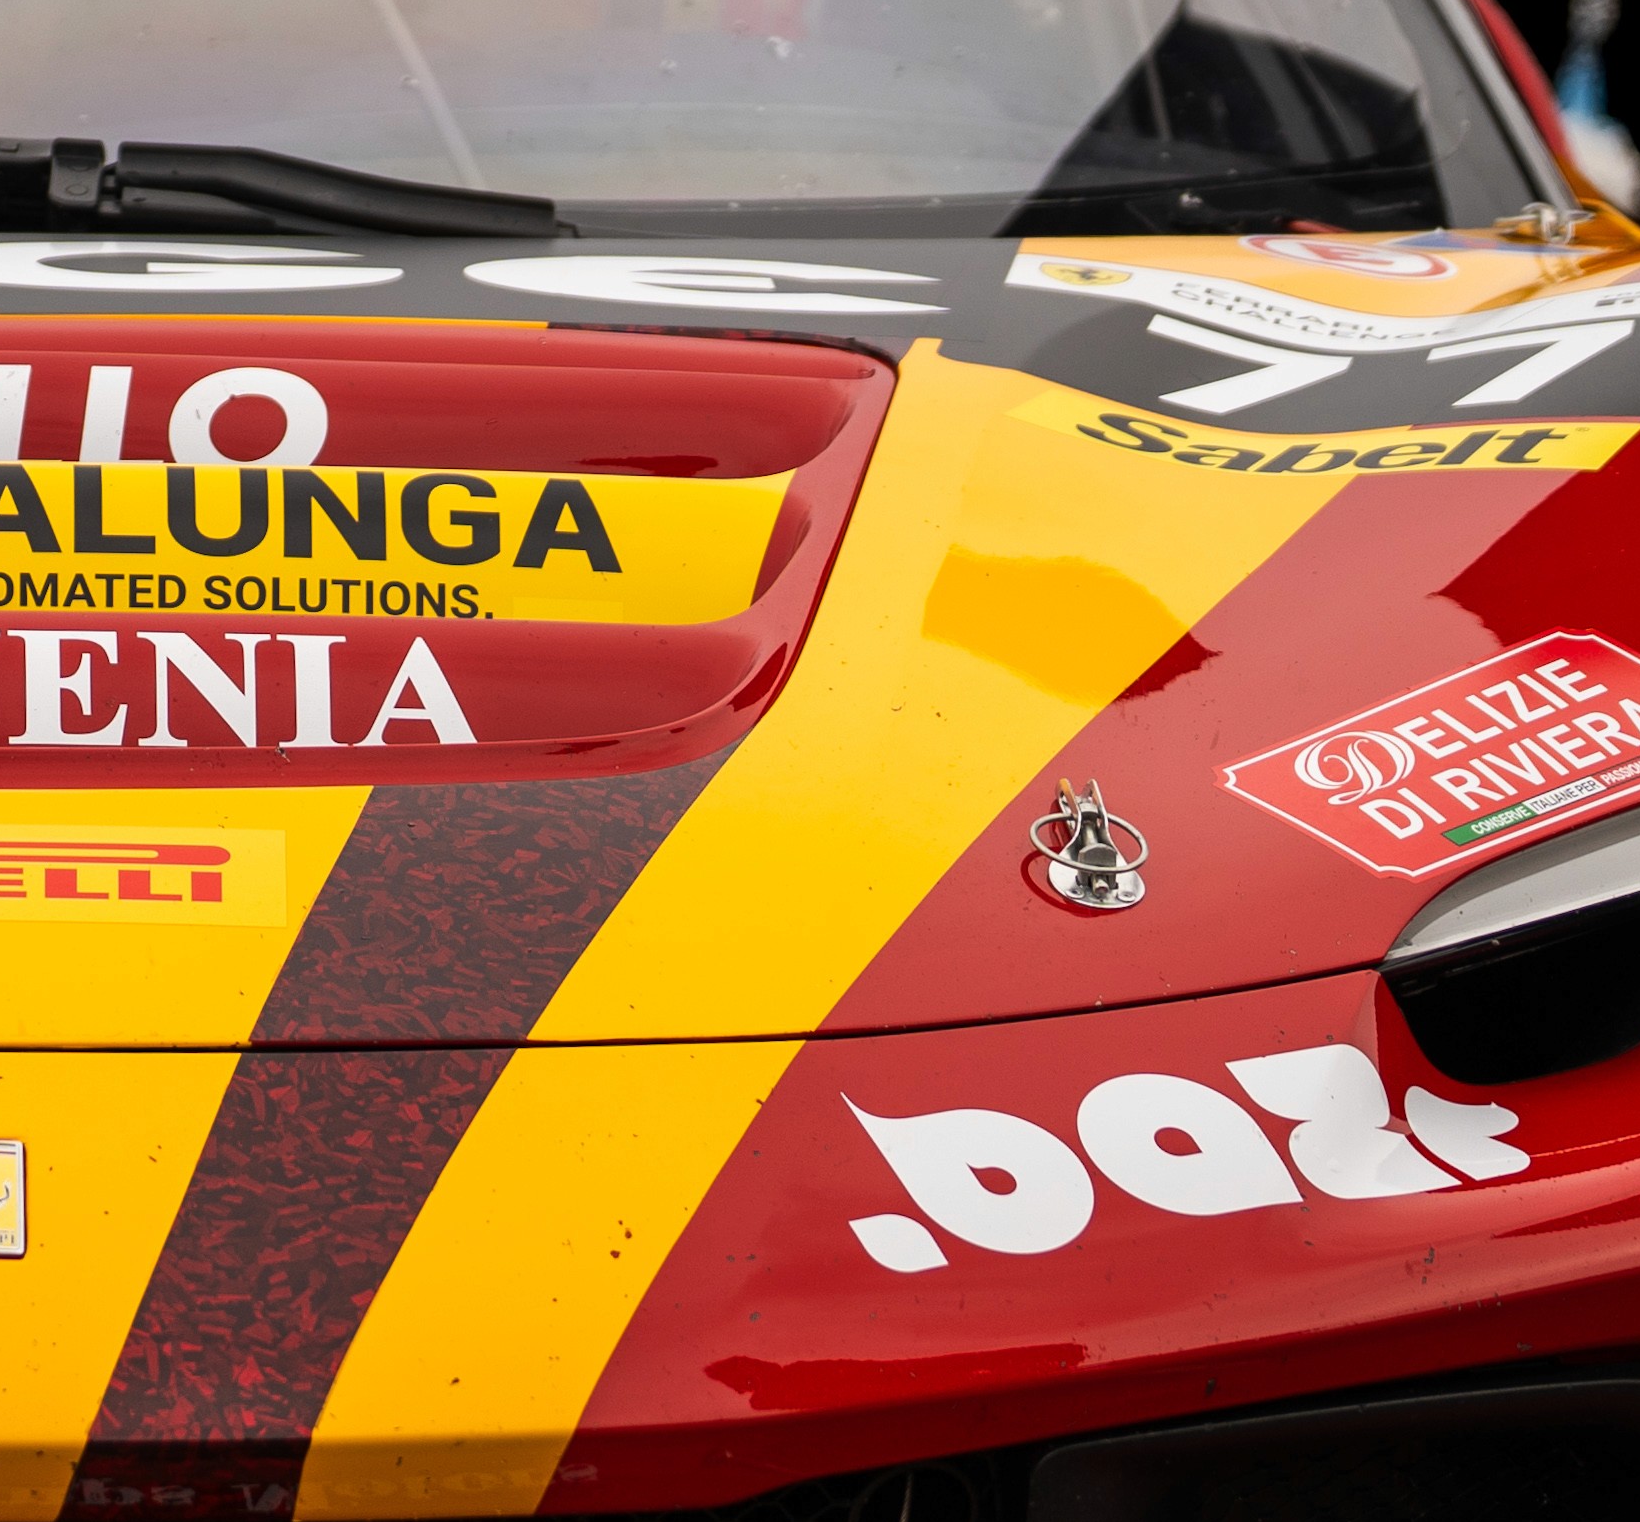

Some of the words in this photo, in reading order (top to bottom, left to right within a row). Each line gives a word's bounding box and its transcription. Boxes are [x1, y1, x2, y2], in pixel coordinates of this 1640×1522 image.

[1170, 288, 1460, 341] CHALLENGE
[1174, 280, 1376, 332] FERRARI
[1147, 314, 1636, 414] 77
[1074, 410, 1568, 476] Sabelt
[202, 574, 495, 620] SOLUTIONS.
[1293, 656, 1609, 806] DELIZIE
[1358, 786, 1448, 840] DI
[1470, 802, 1533, 836] CONSERVE
[1528, 786, 1579, 814] ITALIANE
[1576, 779, 1602, 796] PER
